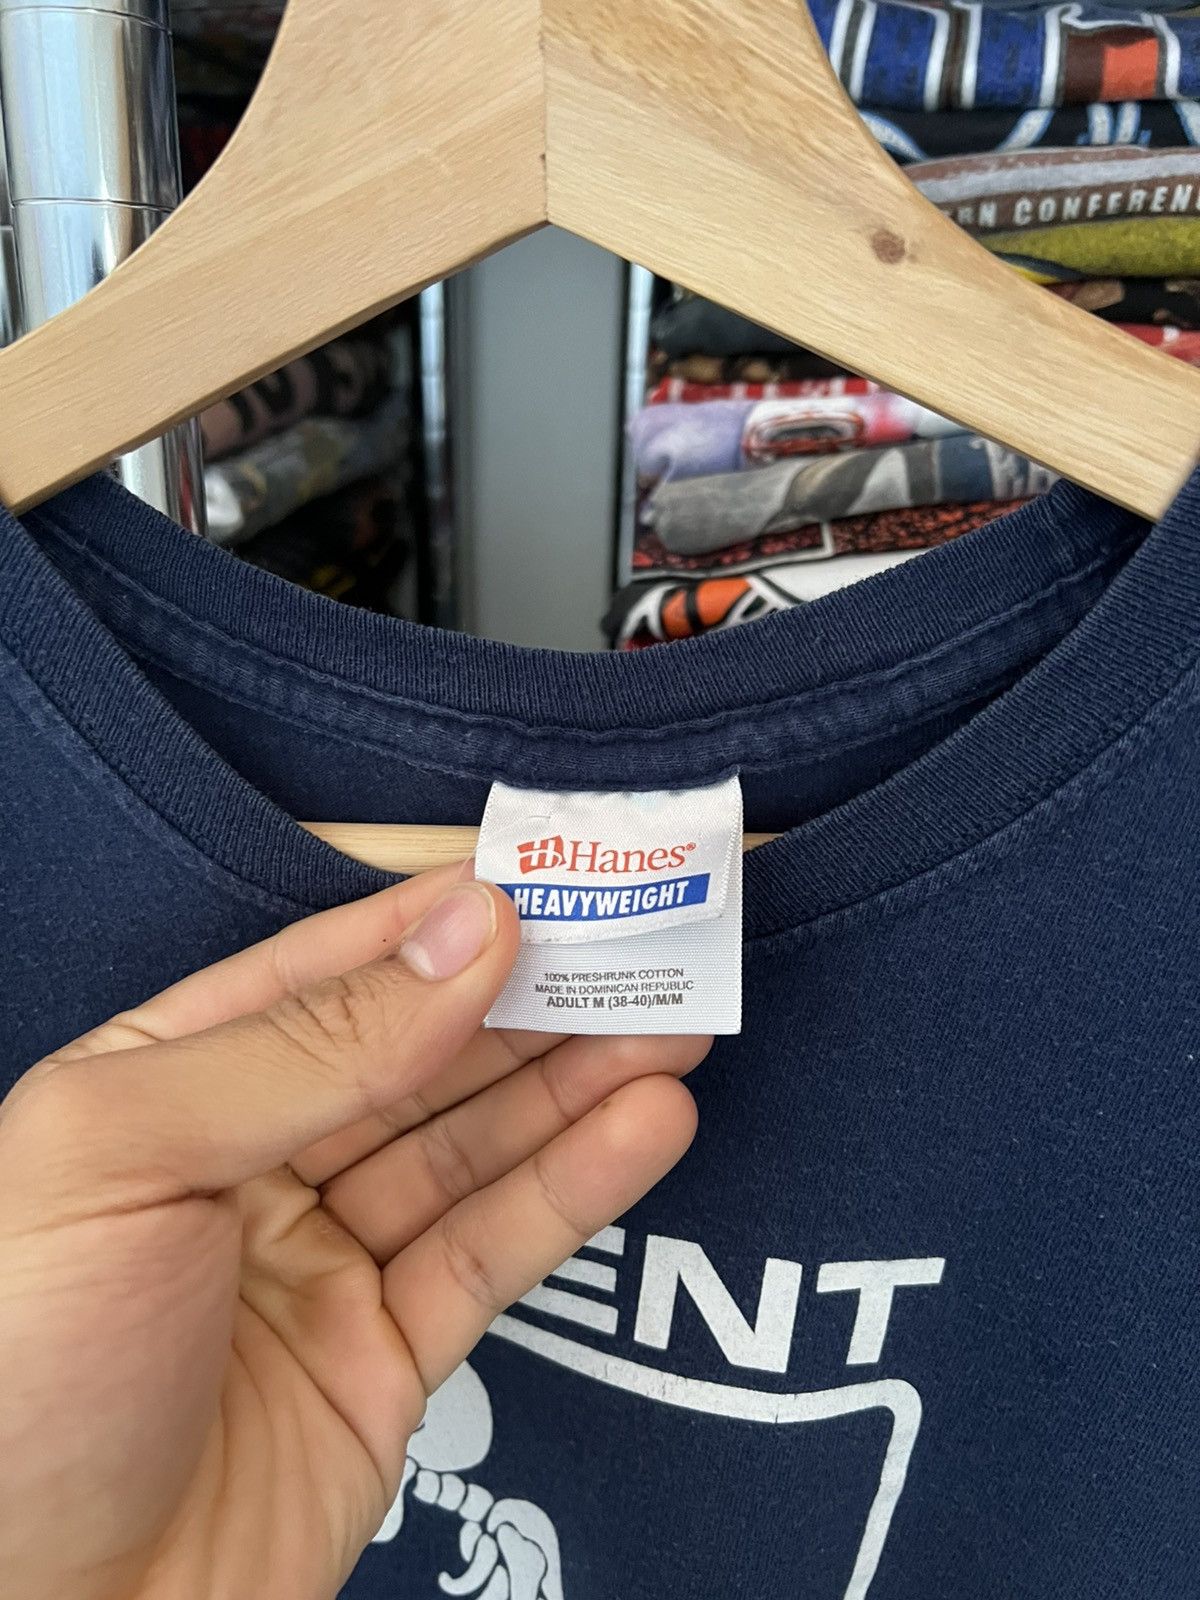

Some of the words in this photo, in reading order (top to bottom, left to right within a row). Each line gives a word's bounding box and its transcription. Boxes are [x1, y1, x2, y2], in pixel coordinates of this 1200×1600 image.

[513, 880, 690, 918] HEAVYWEIGHT
[544, 972, 570, 983] 100%
[571, 970, 637, 983] PRESHRUNK
[638, 968, 685, 980] COTTON
[535, 983, 564, 995] MADE
[566, 984, 577, 995] IN
[578, 982, 639, 995] DOMINICAN
[641, 980, 695, 992] REPUBLIC
[546, 995, 589, 1008] ADULT
[593, 996, 605, 1008] M
[608, 993, 684, 1010] (38-40)/M/M
